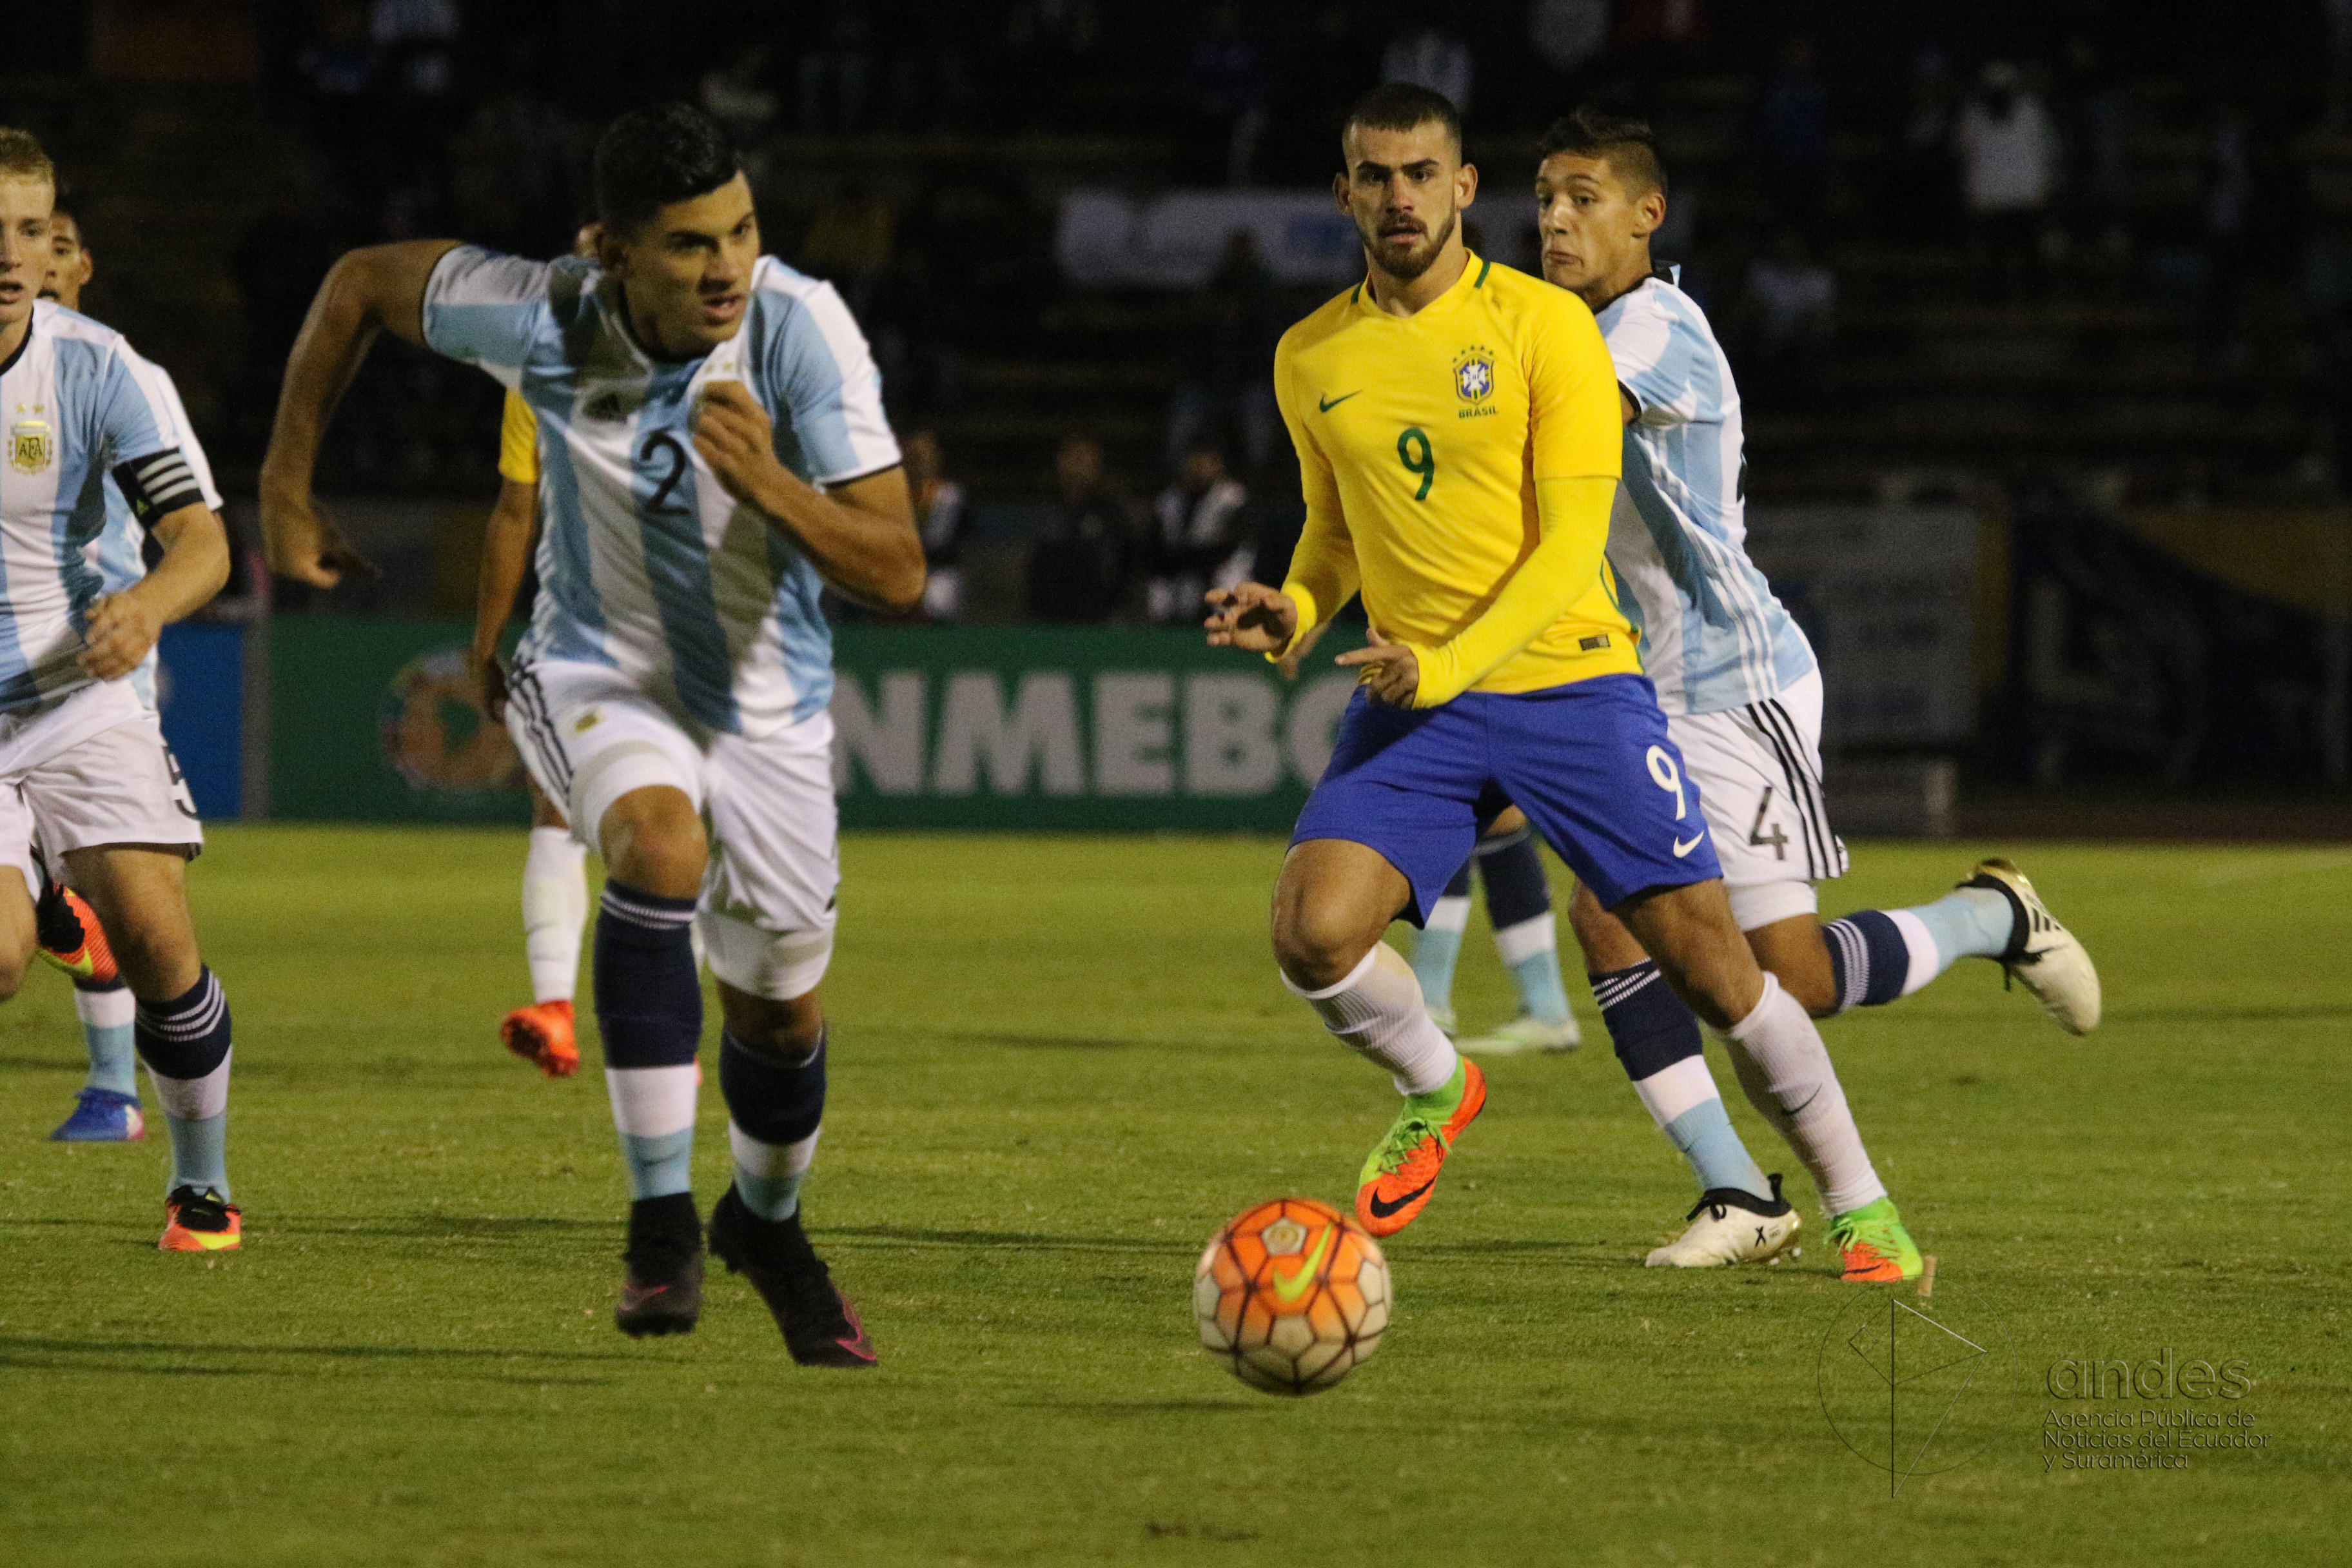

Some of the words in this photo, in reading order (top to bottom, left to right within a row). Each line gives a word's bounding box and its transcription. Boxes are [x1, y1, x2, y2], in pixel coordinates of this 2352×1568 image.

[19, 437, 43, 460] AFA
[1458, 406, 1498, 418] BRASIL
[641, 430, 689, 514] 2
[1398, 427, 1435, 501] 9
[1646, 745, 1686, 820] 9
[1750, 786, 1788, 861] 4
